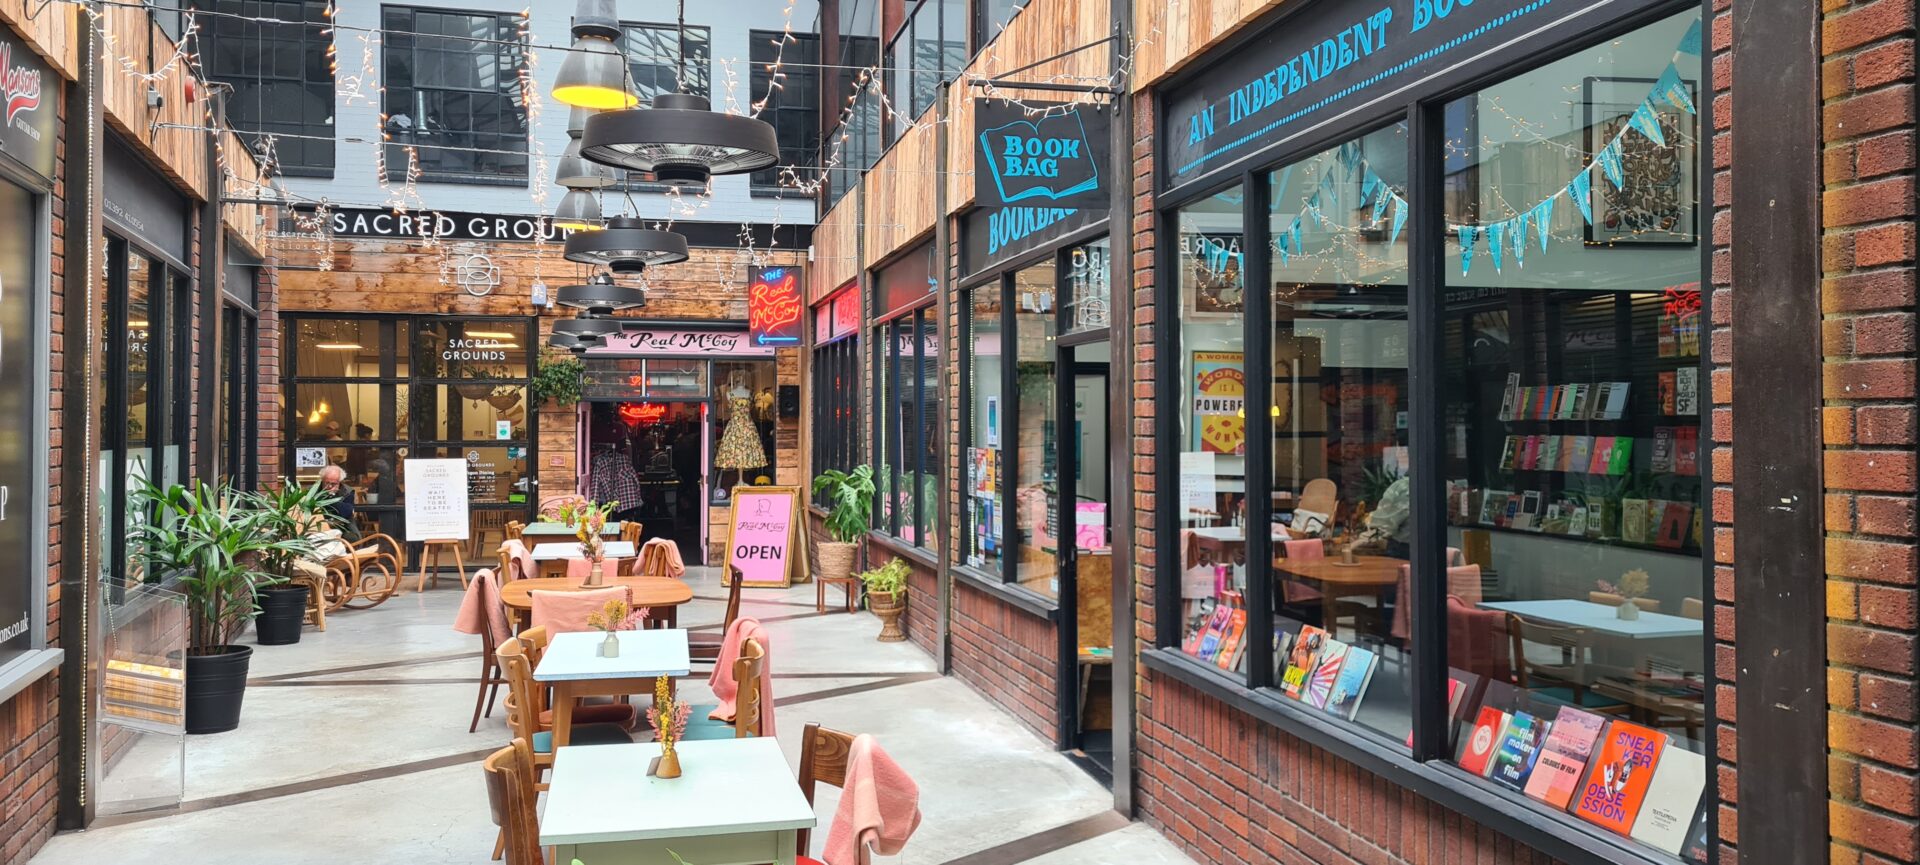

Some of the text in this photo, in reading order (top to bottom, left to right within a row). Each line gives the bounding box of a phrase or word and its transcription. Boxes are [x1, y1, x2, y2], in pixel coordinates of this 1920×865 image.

[1188, 105, 1216, 147] AN
[1228, 6, 1393, 126] INDEPENDENT
[16, 117, 41, 141] GUITAR SHOP
[1003, 135, 1080, 159] BOOK
[1003, 157, 1059, 177] BAG
[333, 212, 456, 237] SACRED
[764, 268, 782, 282] THE
[749, 275, 793, 307] Real
[751, 295, 801, 333] McCoy
[449, 339, 499, 348] SACRED
[613, 332, 741, 351] THE Real McCoy
[442, 351, 506, 361] GROUNDS
[1678, 398, 1691, 413] SF
[738, 521, 785, 533] Real McCoy
[736, 545, 782, 560] OPEN
[1519, 727, 1534, 742] film
[1616, 731, 1656, 755] SNEA
[1507, 738, 1536, 755] makers
[1511, 754, 1522, 763] on
[1541, 757, 1577, 775] COLOURS OF FILM
[1622, 748, 1653, 769] KER
[1503, 764, 1520, 780] film
[1587, 782, 1626, 807] OBSE
[1581, 796, 1626, 823] SSION
